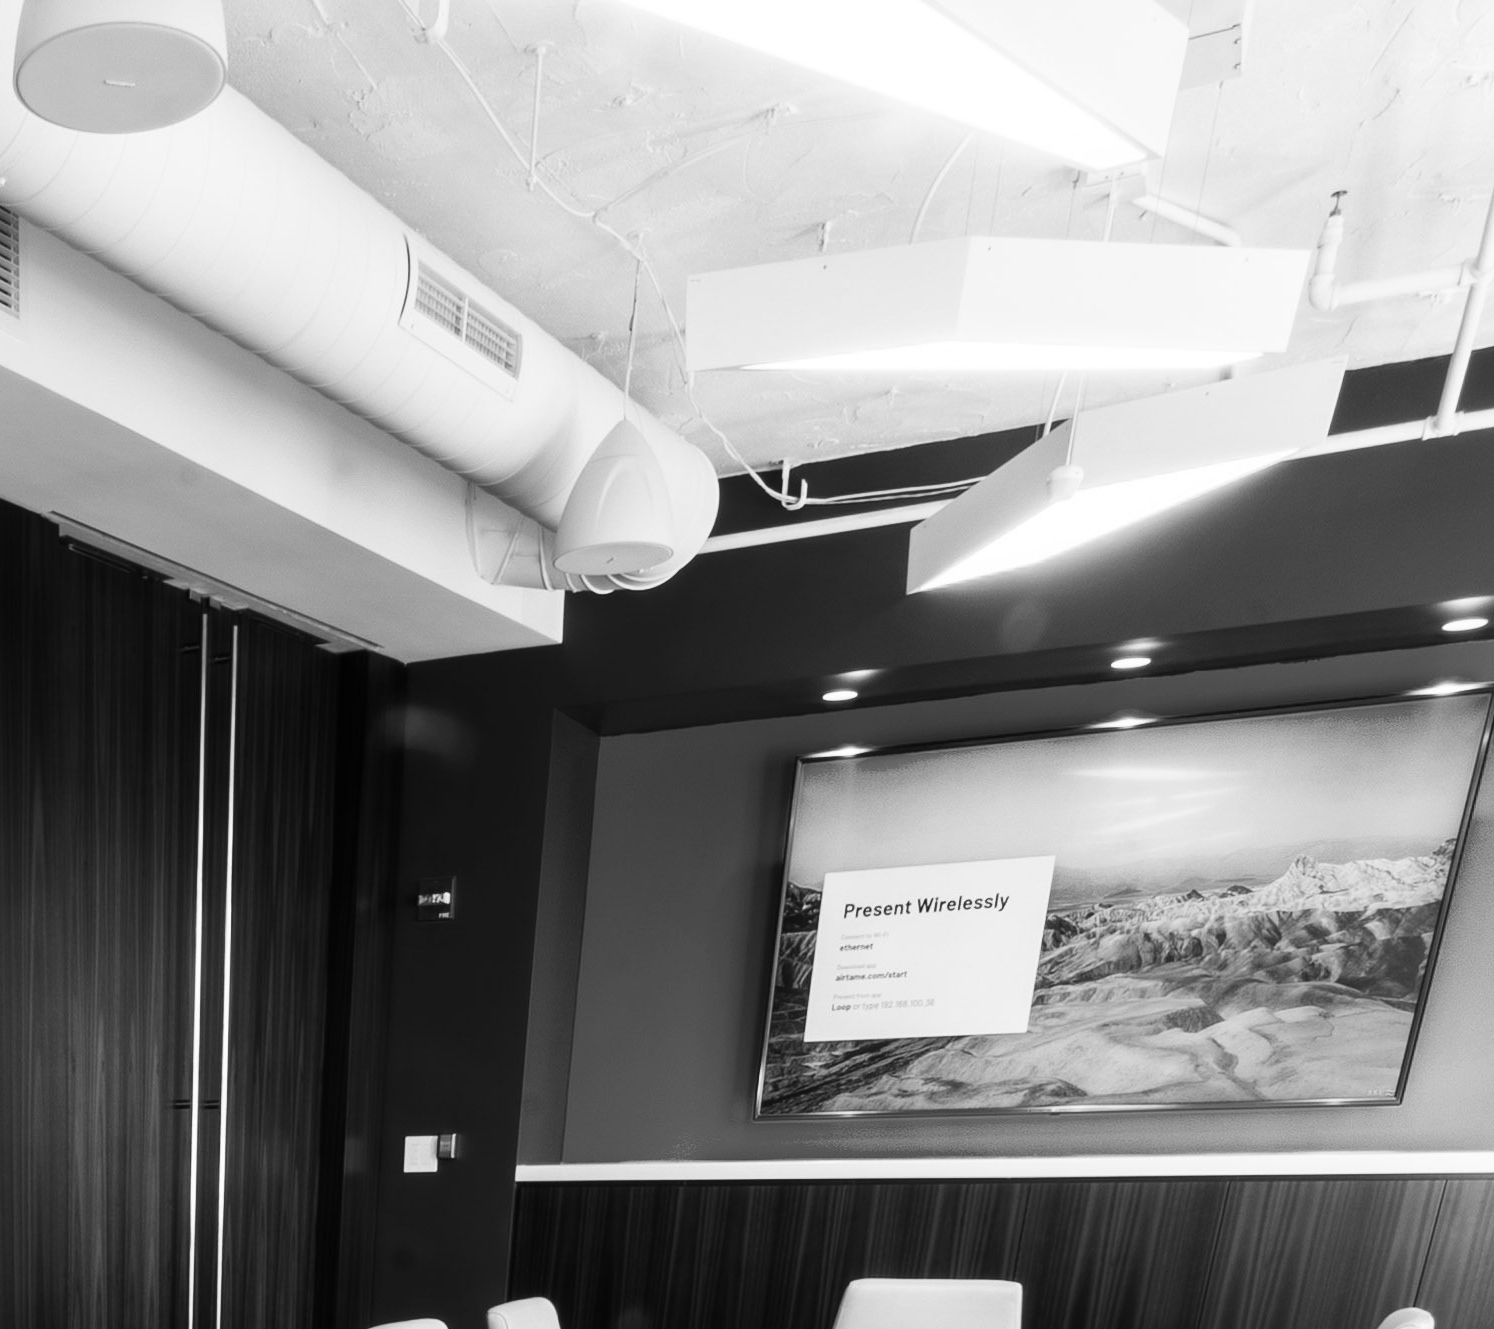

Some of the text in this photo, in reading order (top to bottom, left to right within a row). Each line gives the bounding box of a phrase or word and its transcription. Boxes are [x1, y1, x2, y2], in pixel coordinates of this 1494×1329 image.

[843, 893, 1010, 919] Present Wirelessly
[839, 943, 874, 951] ethernet
[834, 971, 907, 981] airtame.com/start
[831, 1003, 851, 1011] Loop
